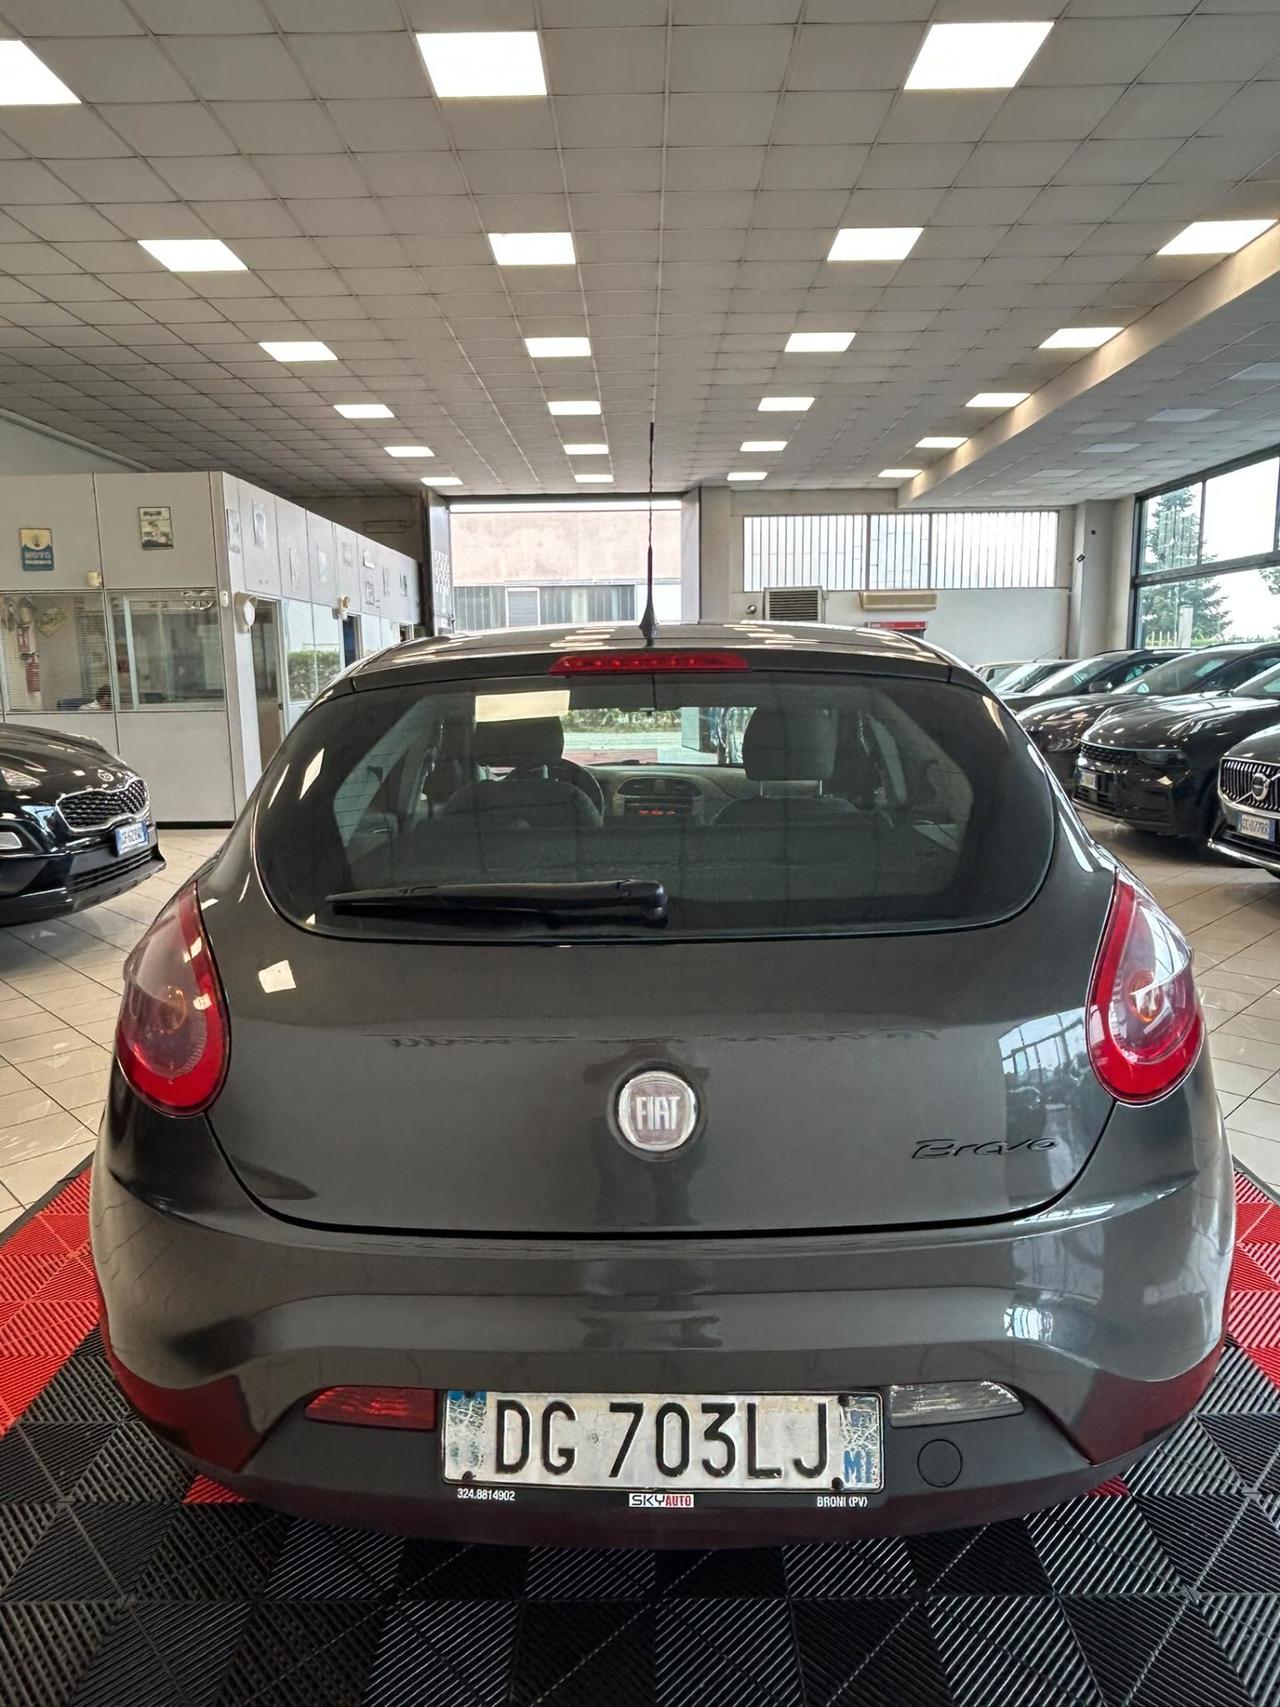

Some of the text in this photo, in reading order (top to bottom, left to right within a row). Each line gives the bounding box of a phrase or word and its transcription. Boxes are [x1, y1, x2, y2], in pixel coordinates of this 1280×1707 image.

[636, 1096, 681, 1130] FIAT
[911, 1137, 1058, 1160] Bravo
[495, 1400, 828, 1479] DG 703LJ
[843, 1450, 873, 1484] MI
[457, 1488, 516, 1501] 324.8814902
[816, 1495, 868, 1508] BRONI (PV)
